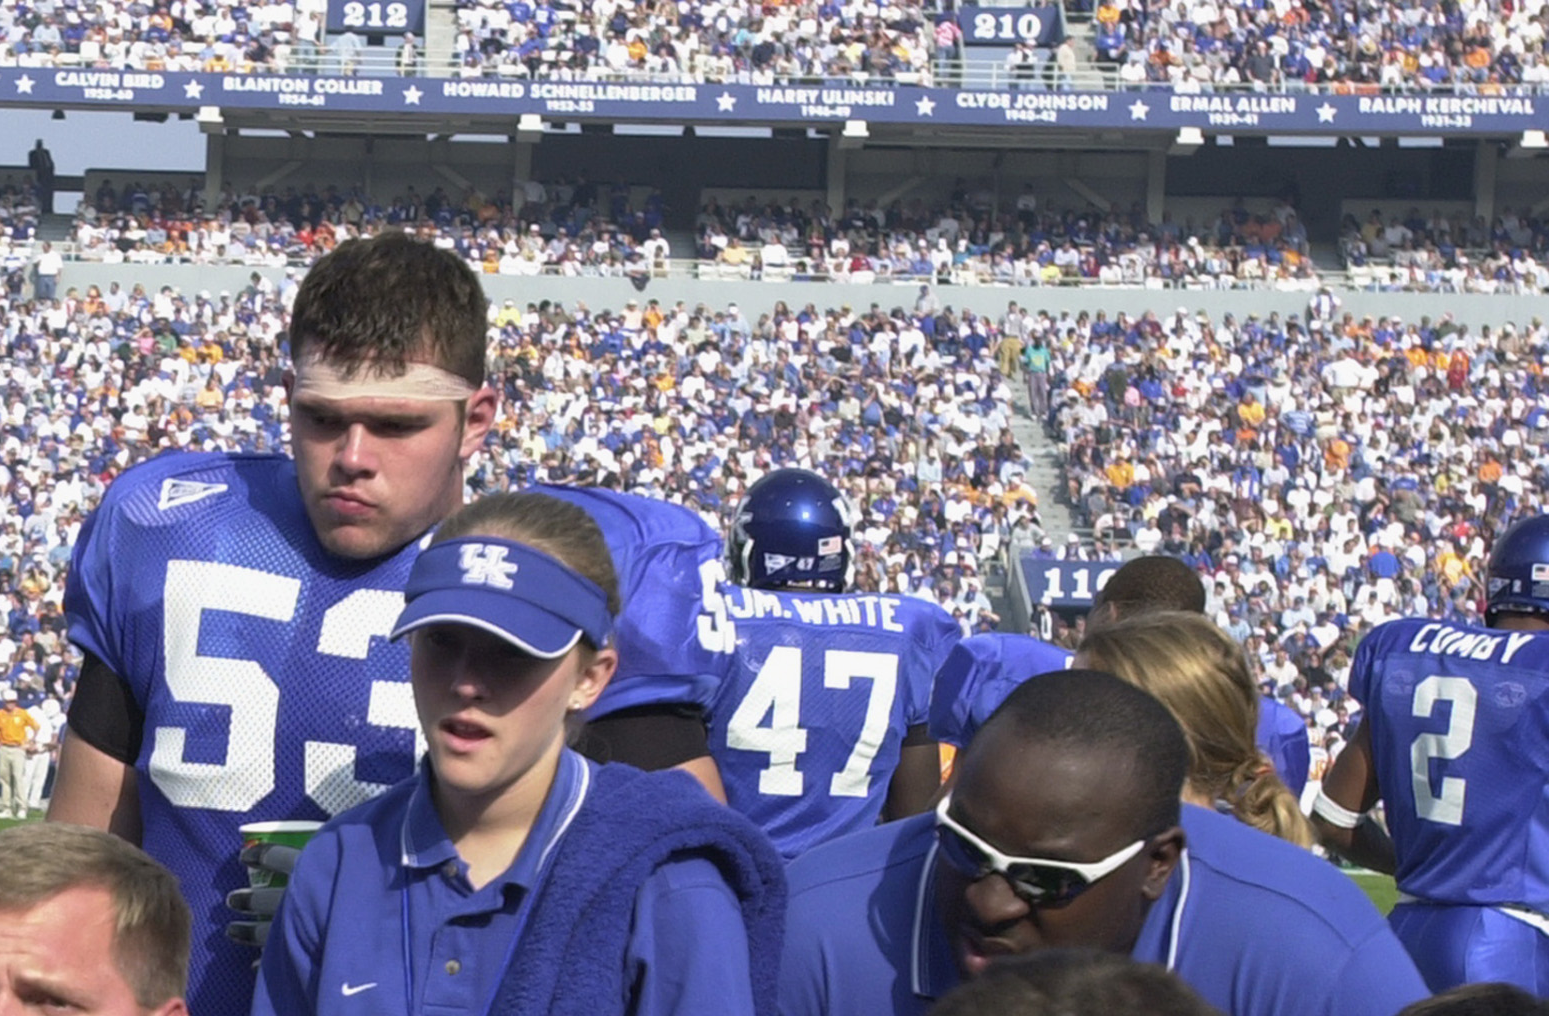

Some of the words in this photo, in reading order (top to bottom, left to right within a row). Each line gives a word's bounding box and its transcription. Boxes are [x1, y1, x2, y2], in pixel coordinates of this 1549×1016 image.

[343, 1, 408, 27] 212
[973, 13, 1042, 39] 210
[55, 72, 121, 88] CALVIN
[122, 74, 165, 90] BIRD
[223, 76, 310, 93] BLANTON
[313, 79, 383, 96] COLLIER
[443, 82, 525, 99] HOWARD
[530, 83, 698, 102] SCHNELLENBERGER
[757, 89, 820, 105] HARRY
[822, 89, 895, 107] ULINSKI
[956, 93, 1011, 110] CLYDE
[1013, 94, 1109, 112] JOHNSON
[1170, 96, 1233, 113] ERMAL
[1236, 97, 1297, 114] ALLEN
[1359, 97, 1422, 115] RALPH
[1425, 98, 1535, 116] KERCHEVAL
[459, 543, 519, 591] UK
[149, 559, 431, 818] 53
[726, 646, 900, 798] 47
[1410, 675, 1479, 827] 2
